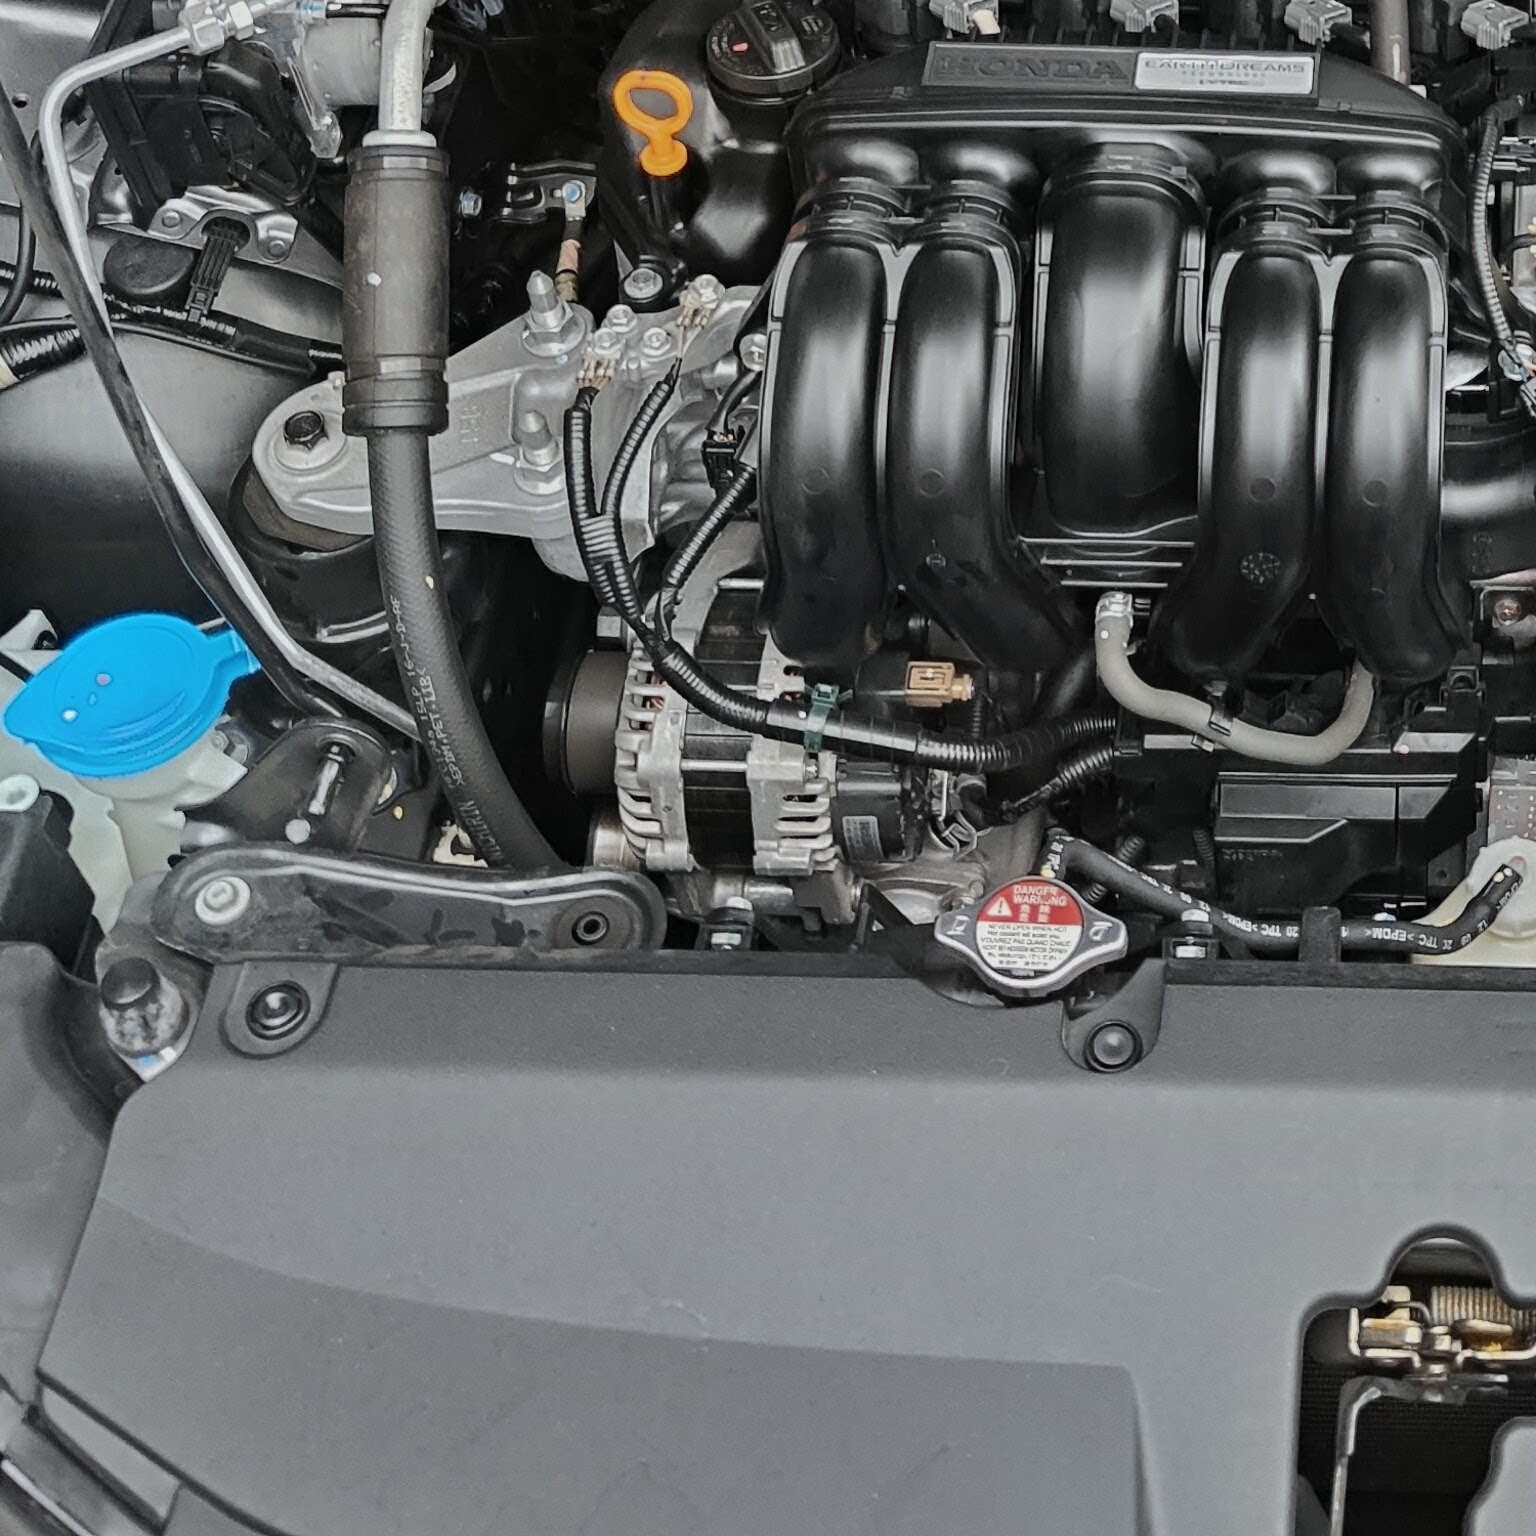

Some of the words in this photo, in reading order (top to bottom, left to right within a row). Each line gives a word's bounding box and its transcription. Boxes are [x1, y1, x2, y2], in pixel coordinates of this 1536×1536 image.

[938, 54, 1129, 81] HONDA
[1014, 895, 1067, 906] WARNG
[1260, 923, 1281, 936] TPC
[1418, 934, 1437, 948] TPC
